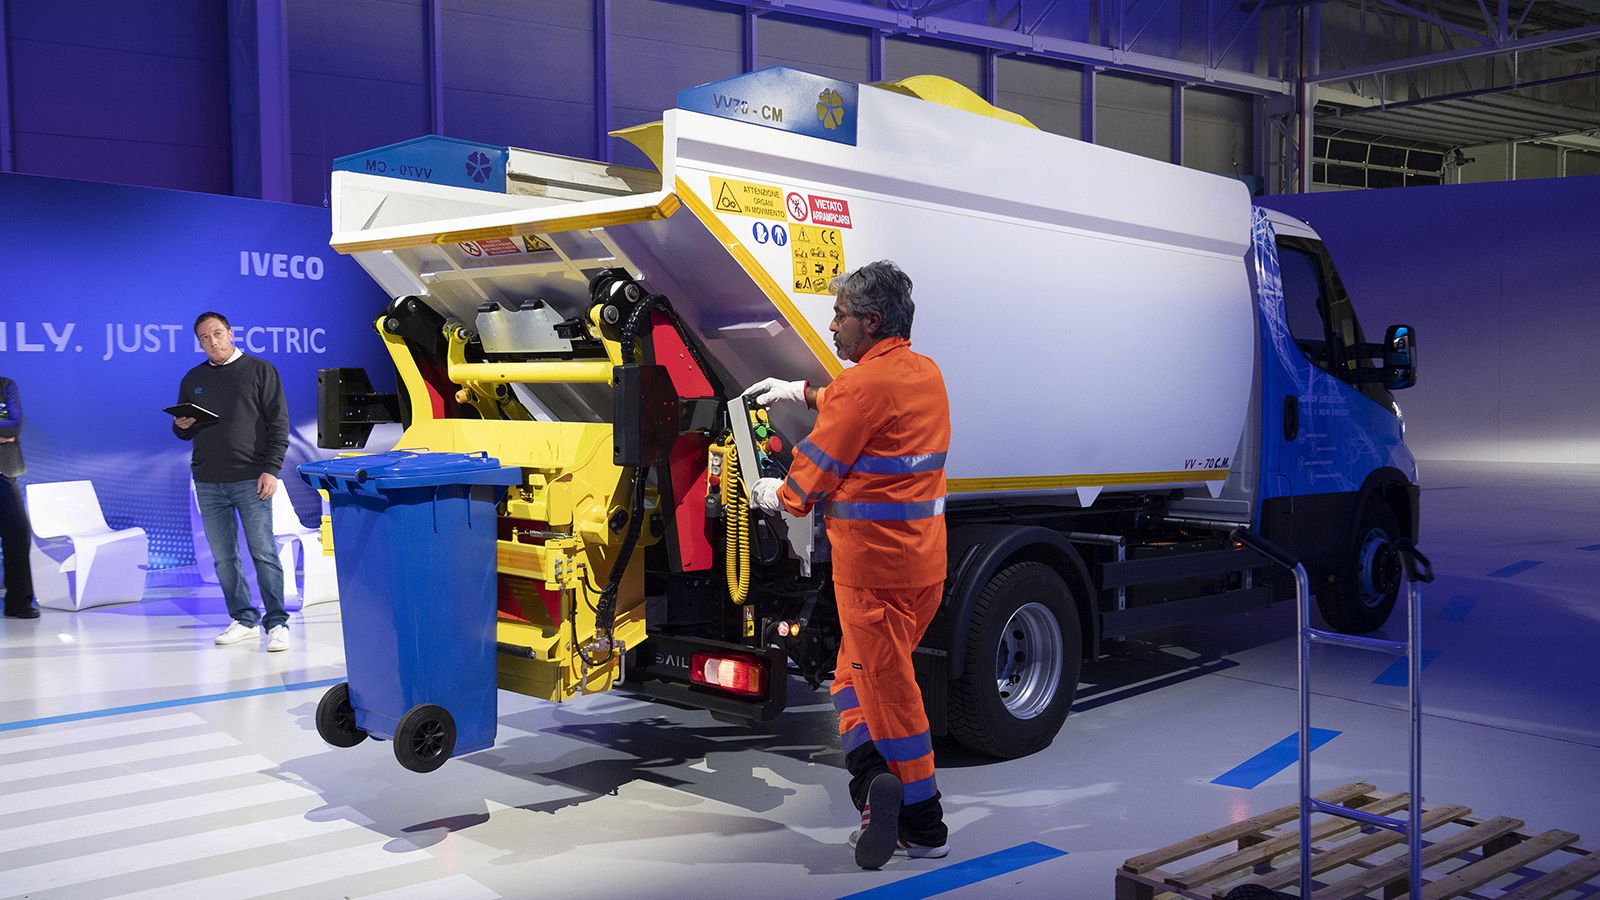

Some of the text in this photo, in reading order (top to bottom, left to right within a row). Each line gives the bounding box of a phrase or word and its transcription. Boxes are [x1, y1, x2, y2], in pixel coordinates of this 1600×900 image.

[712, 93, 749, 115] VV70
[761, 105, 783, 122] CM
[743, 186, 780, 198] ATTENZIONE
[814, 198, 843, 212] VIETATO
[240, 251, 325, 281] IVECO
[103, 323, 183, 361] JUST
[194, 325, 327, 354] ECTRIC
